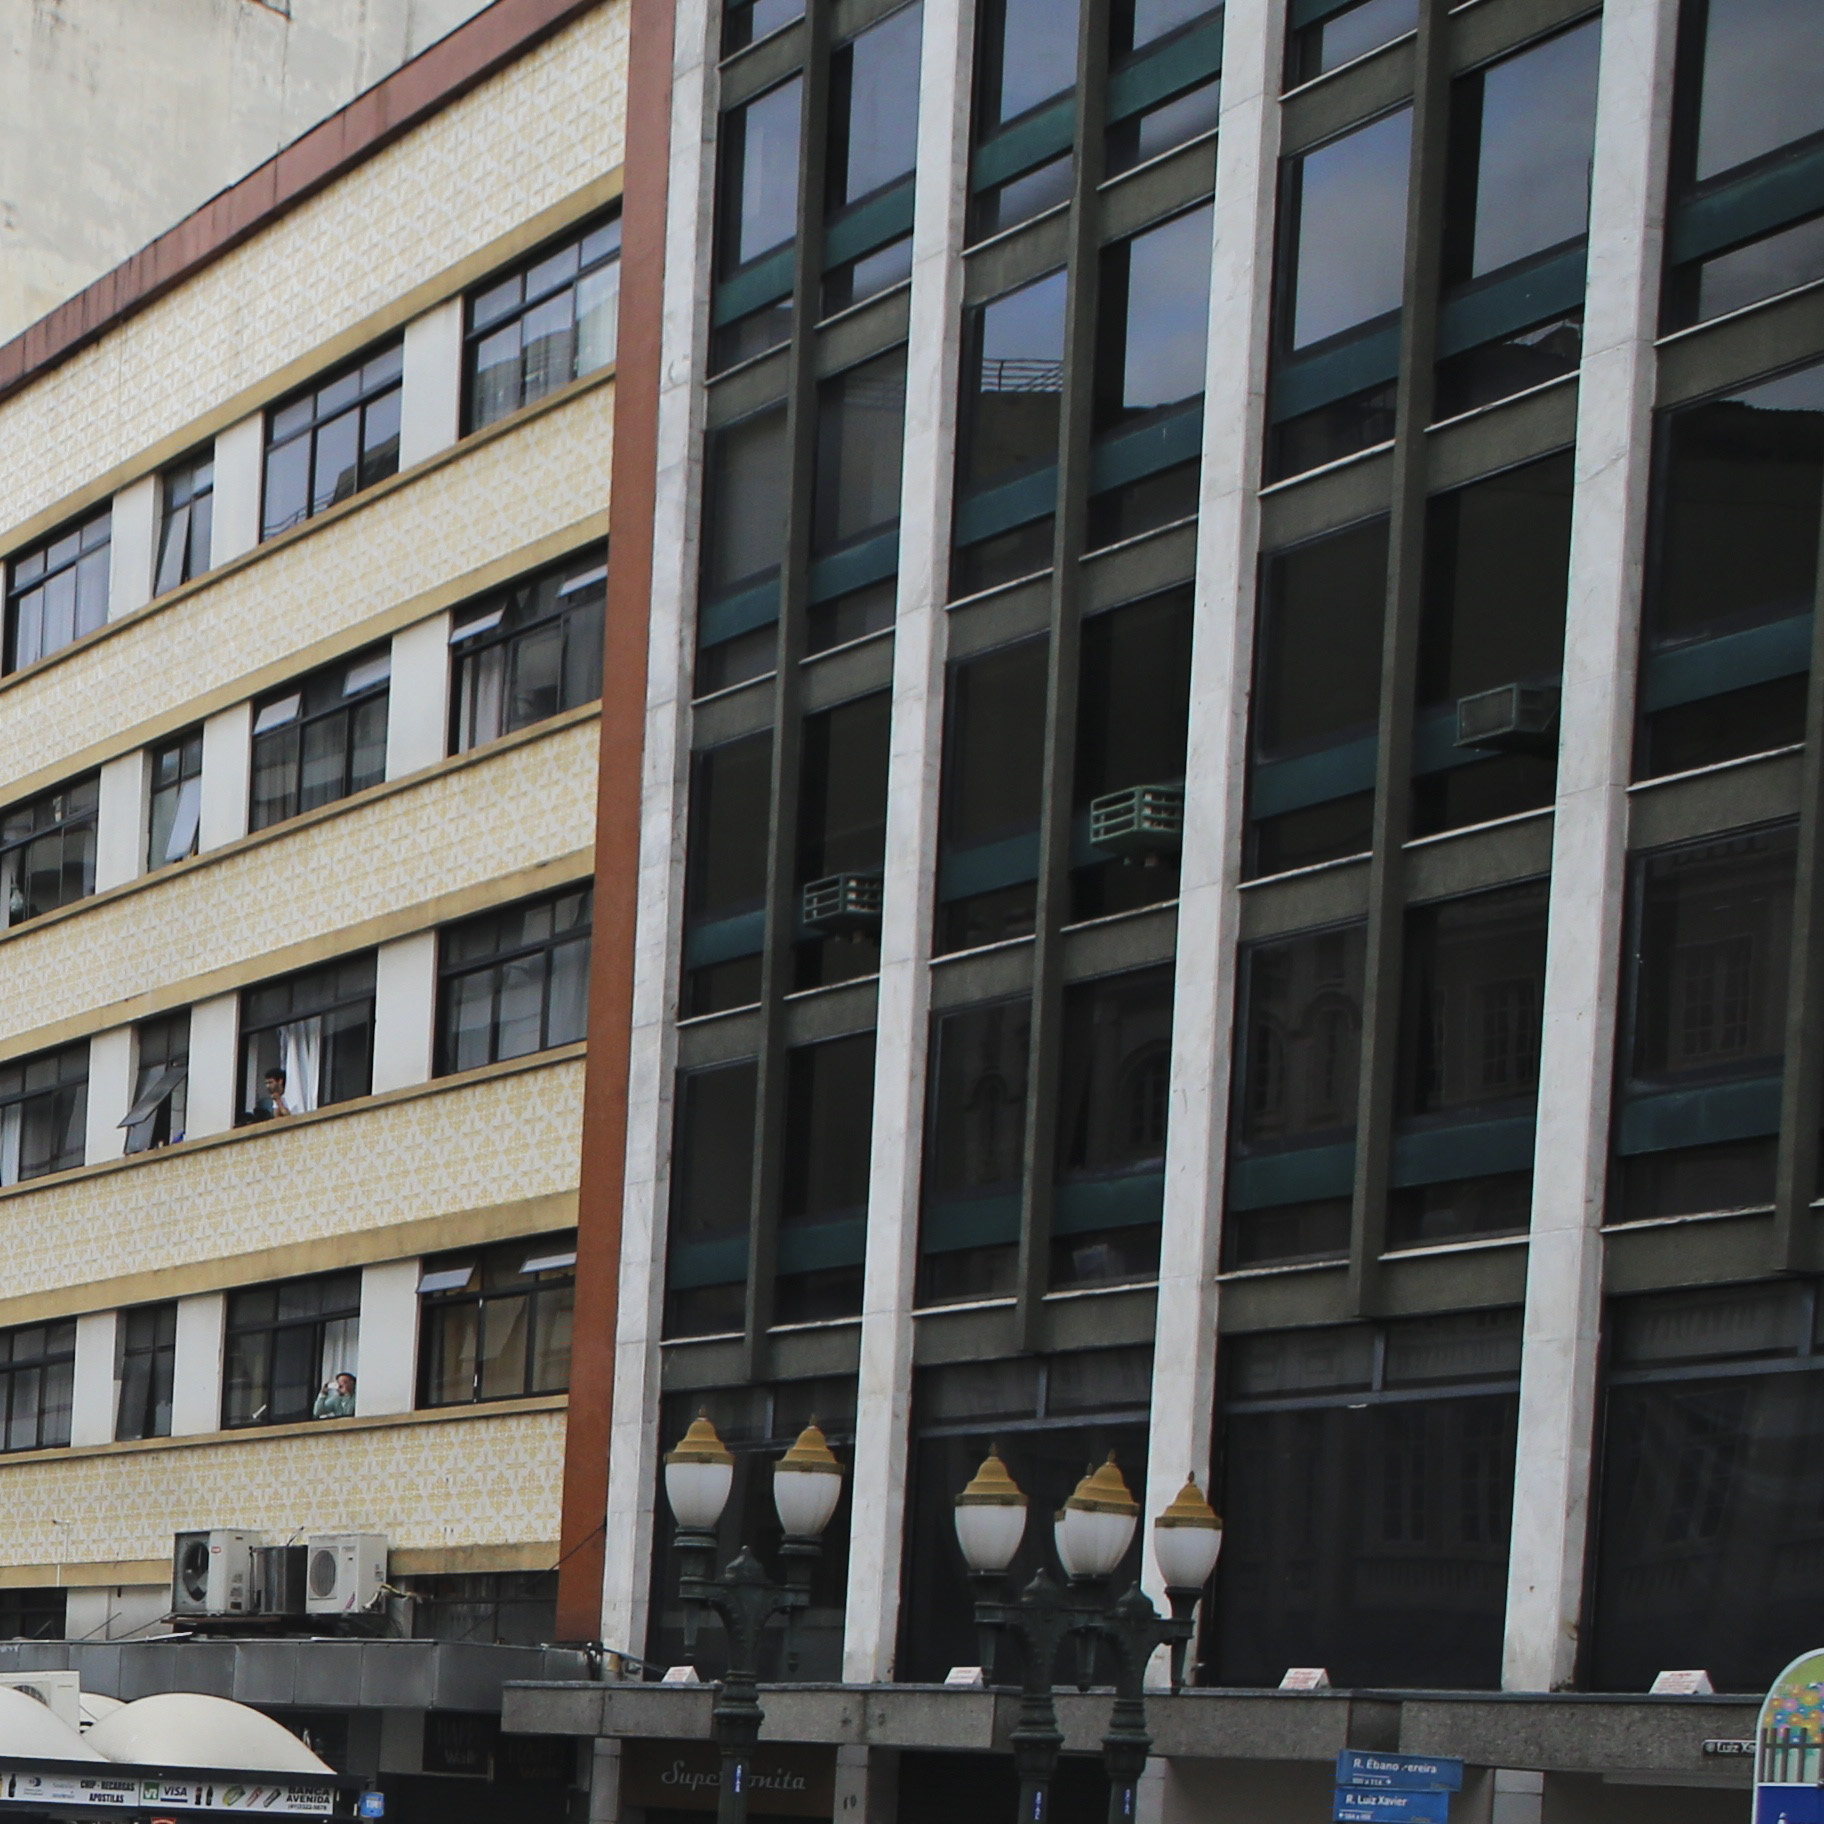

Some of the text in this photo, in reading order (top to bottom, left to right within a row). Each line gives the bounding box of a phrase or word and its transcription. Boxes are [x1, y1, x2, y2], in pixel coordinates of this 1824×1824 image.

[1400, 1760, 1437, 1774] ereira
[163, 1786, 188, 1796] VISA
[286, 1794, 330, 1805] AVENIDA
[1357, 1794, 1376, 1806] Luiz
[1378, 1796, 1408, 1807] Xavier
